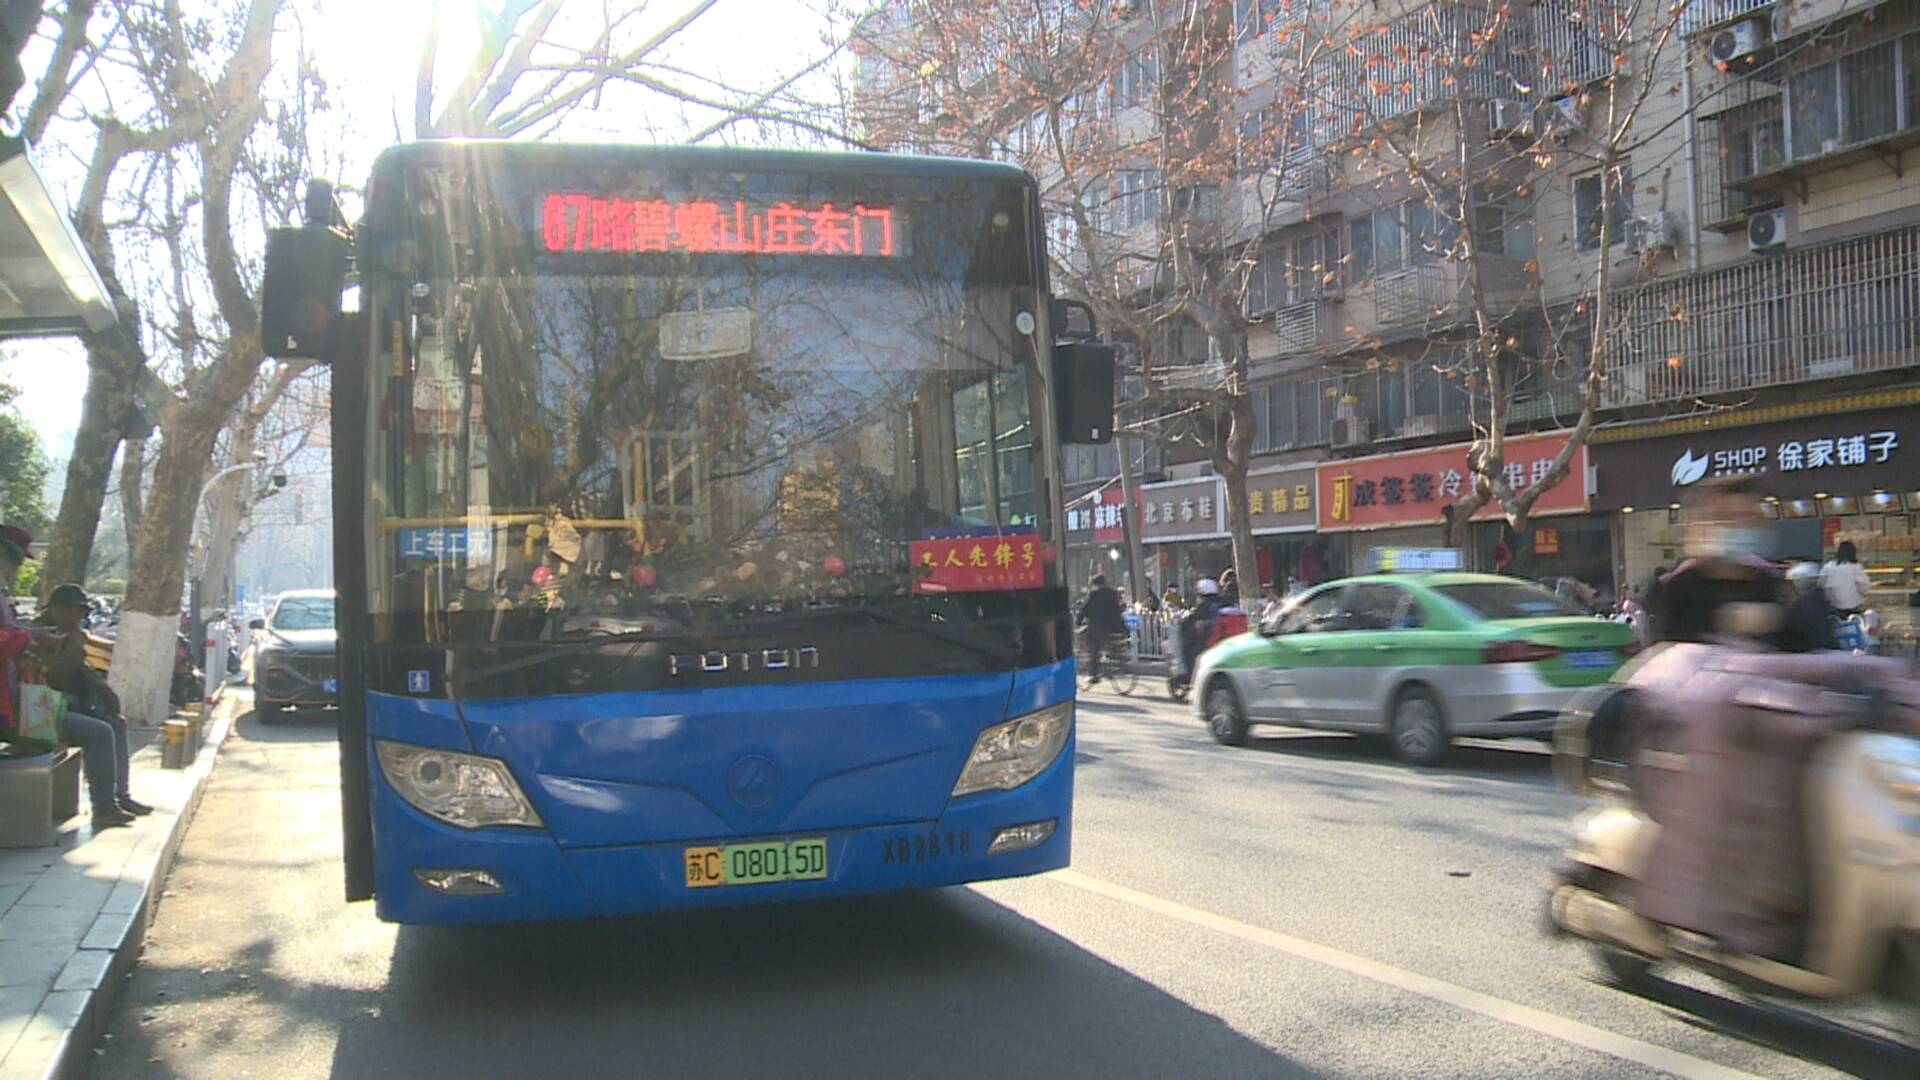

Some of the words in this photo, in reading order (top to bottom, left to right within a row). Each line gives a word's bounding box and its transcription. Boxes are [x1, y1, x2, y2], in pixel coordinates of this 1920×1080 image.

[1714, 447, 1767, 469] SHOP
[1777, 431, 1898, 471] 徐家铺子
[921, 543, 1035, 570] 工人先锋号
